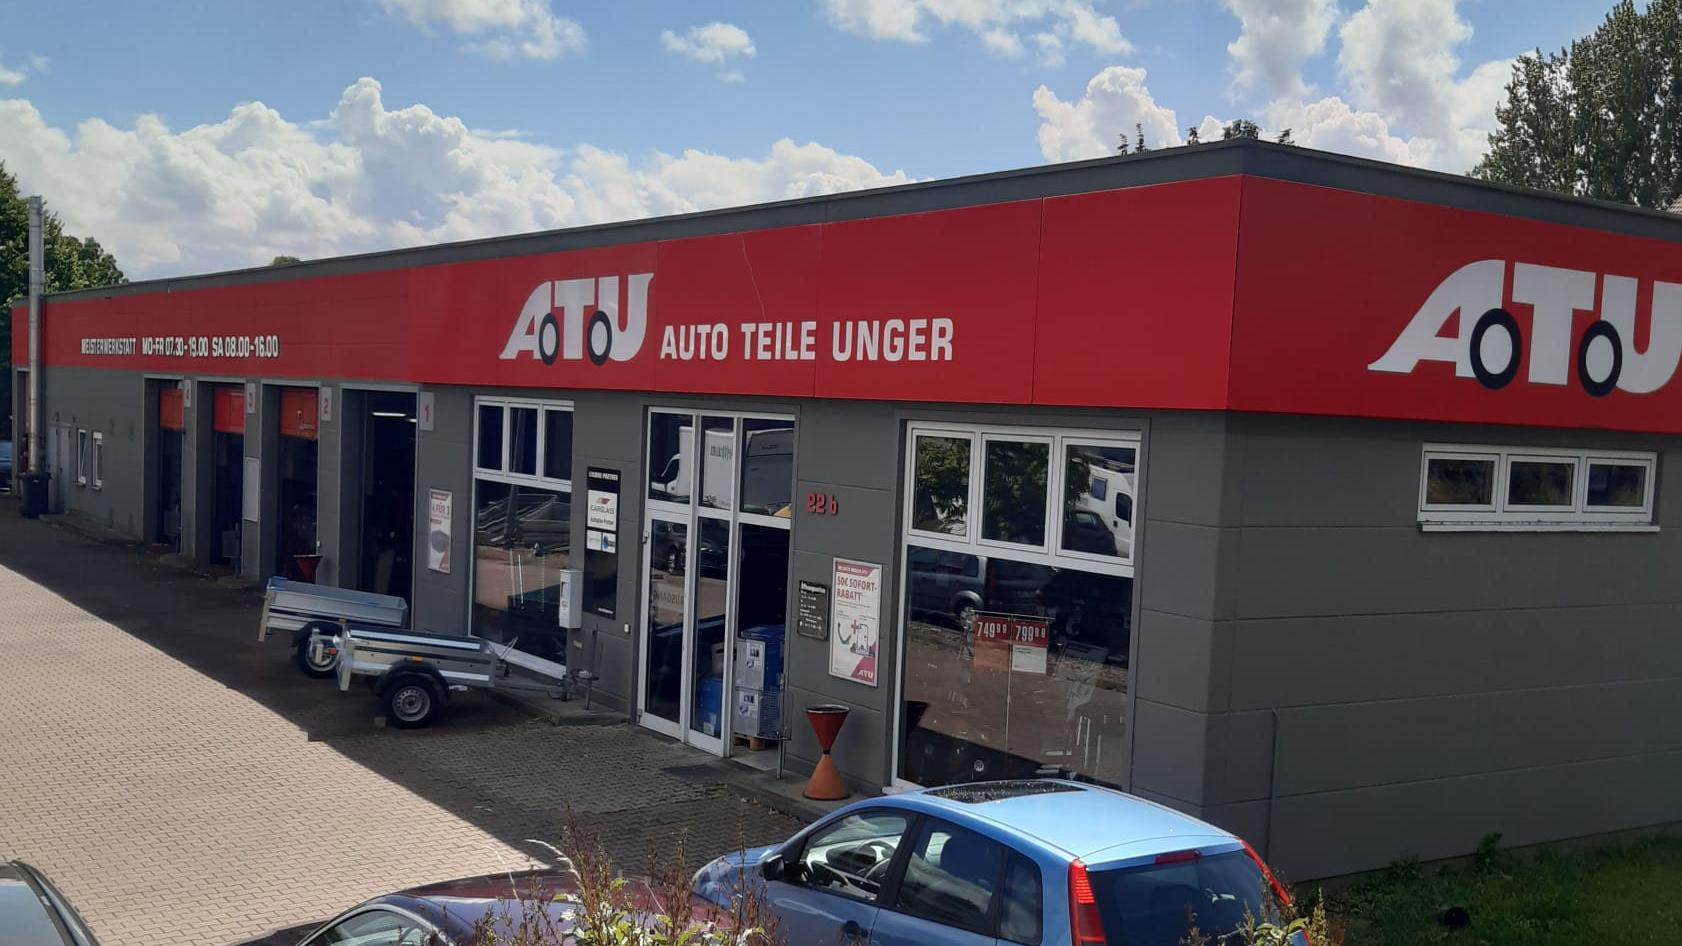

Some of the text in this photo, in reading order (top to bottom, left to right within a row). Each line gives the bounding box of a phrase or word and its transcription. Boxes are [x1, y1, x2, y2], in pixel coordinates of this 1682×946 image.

[499, 272, 654, 366] ATU
[660, 317, 954, 363] AUTO TEILE UNGER
[1367, 258, 1682, 398] ATU
[80, 338, 136, 355] MEISTERWERKSTATT
[142, 337, 164, 355] MO-FR
[212, 337, 224, 358] SA
[807, 493, 838, 515] 22 b
